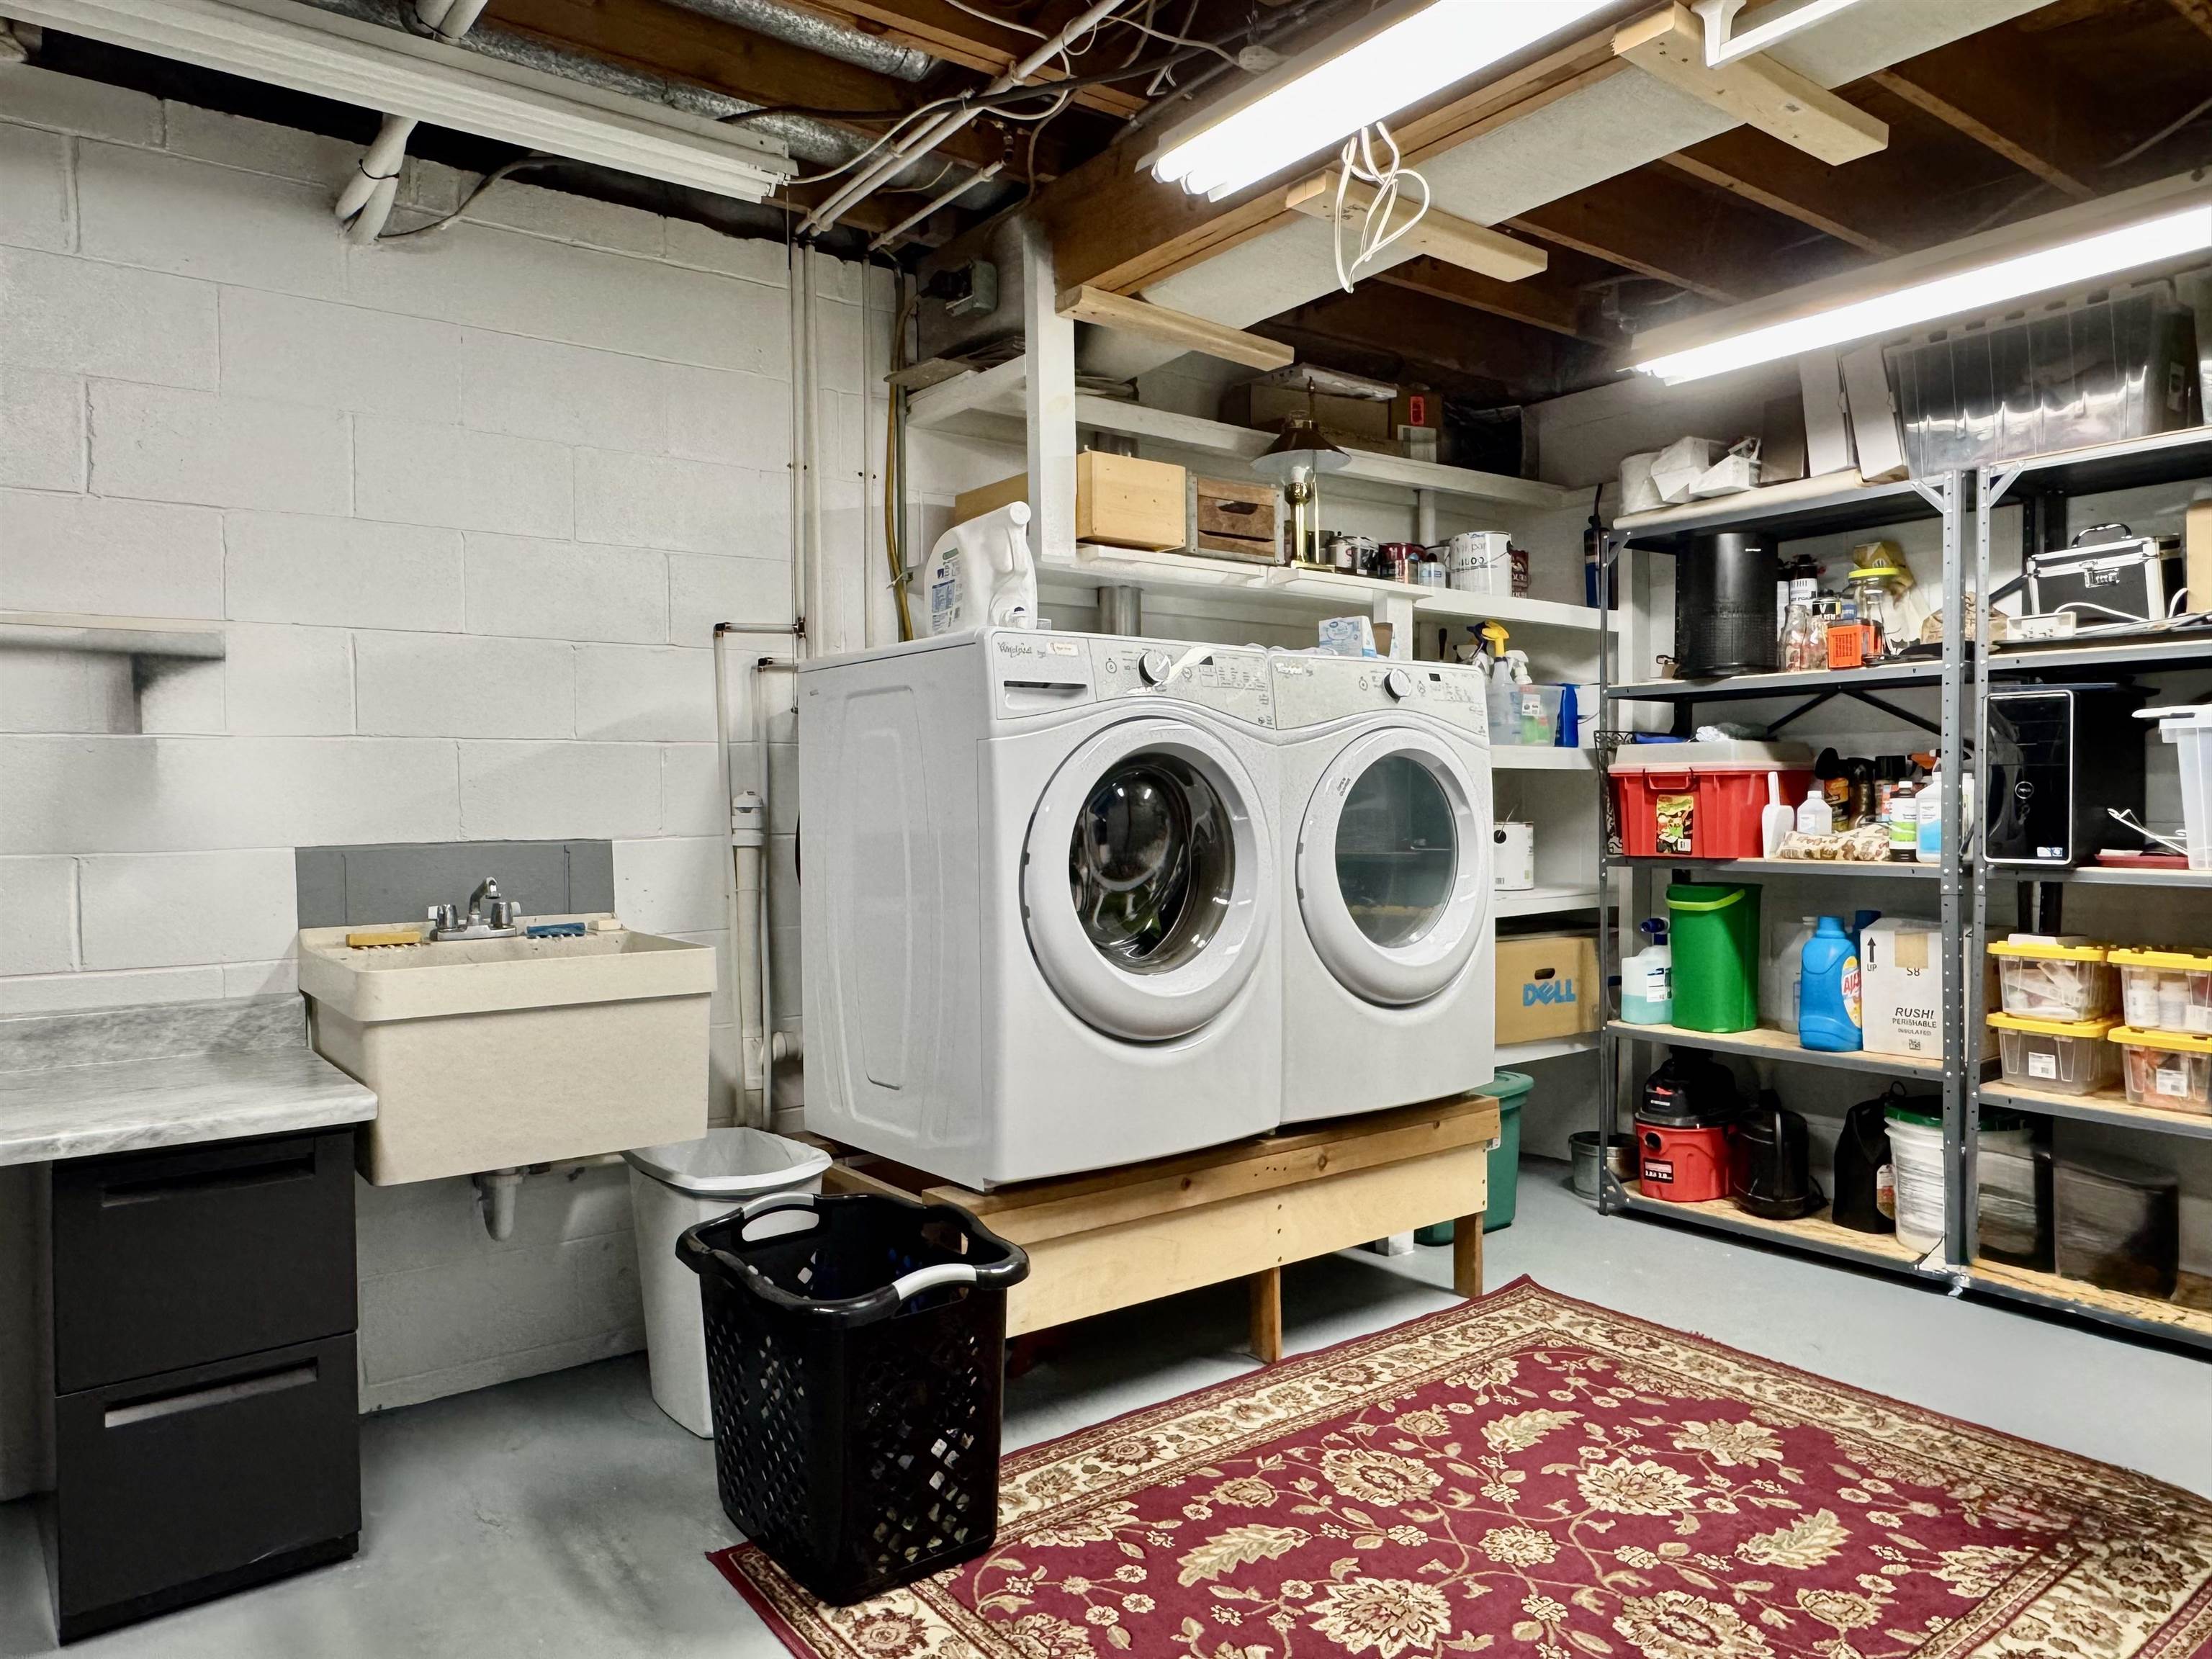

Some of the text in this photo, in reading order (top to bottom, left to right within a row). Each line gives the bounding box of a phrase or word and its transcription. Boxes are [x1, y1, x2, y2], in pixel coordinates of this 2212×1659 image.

[1866, 963, 1877, 972] UP
[1523, 979, 1576, 1007] DELL
[1894, 1007, 1935, 1020] RUSH!
[1892, 1017, 1937, 1028] PERISHABLE
